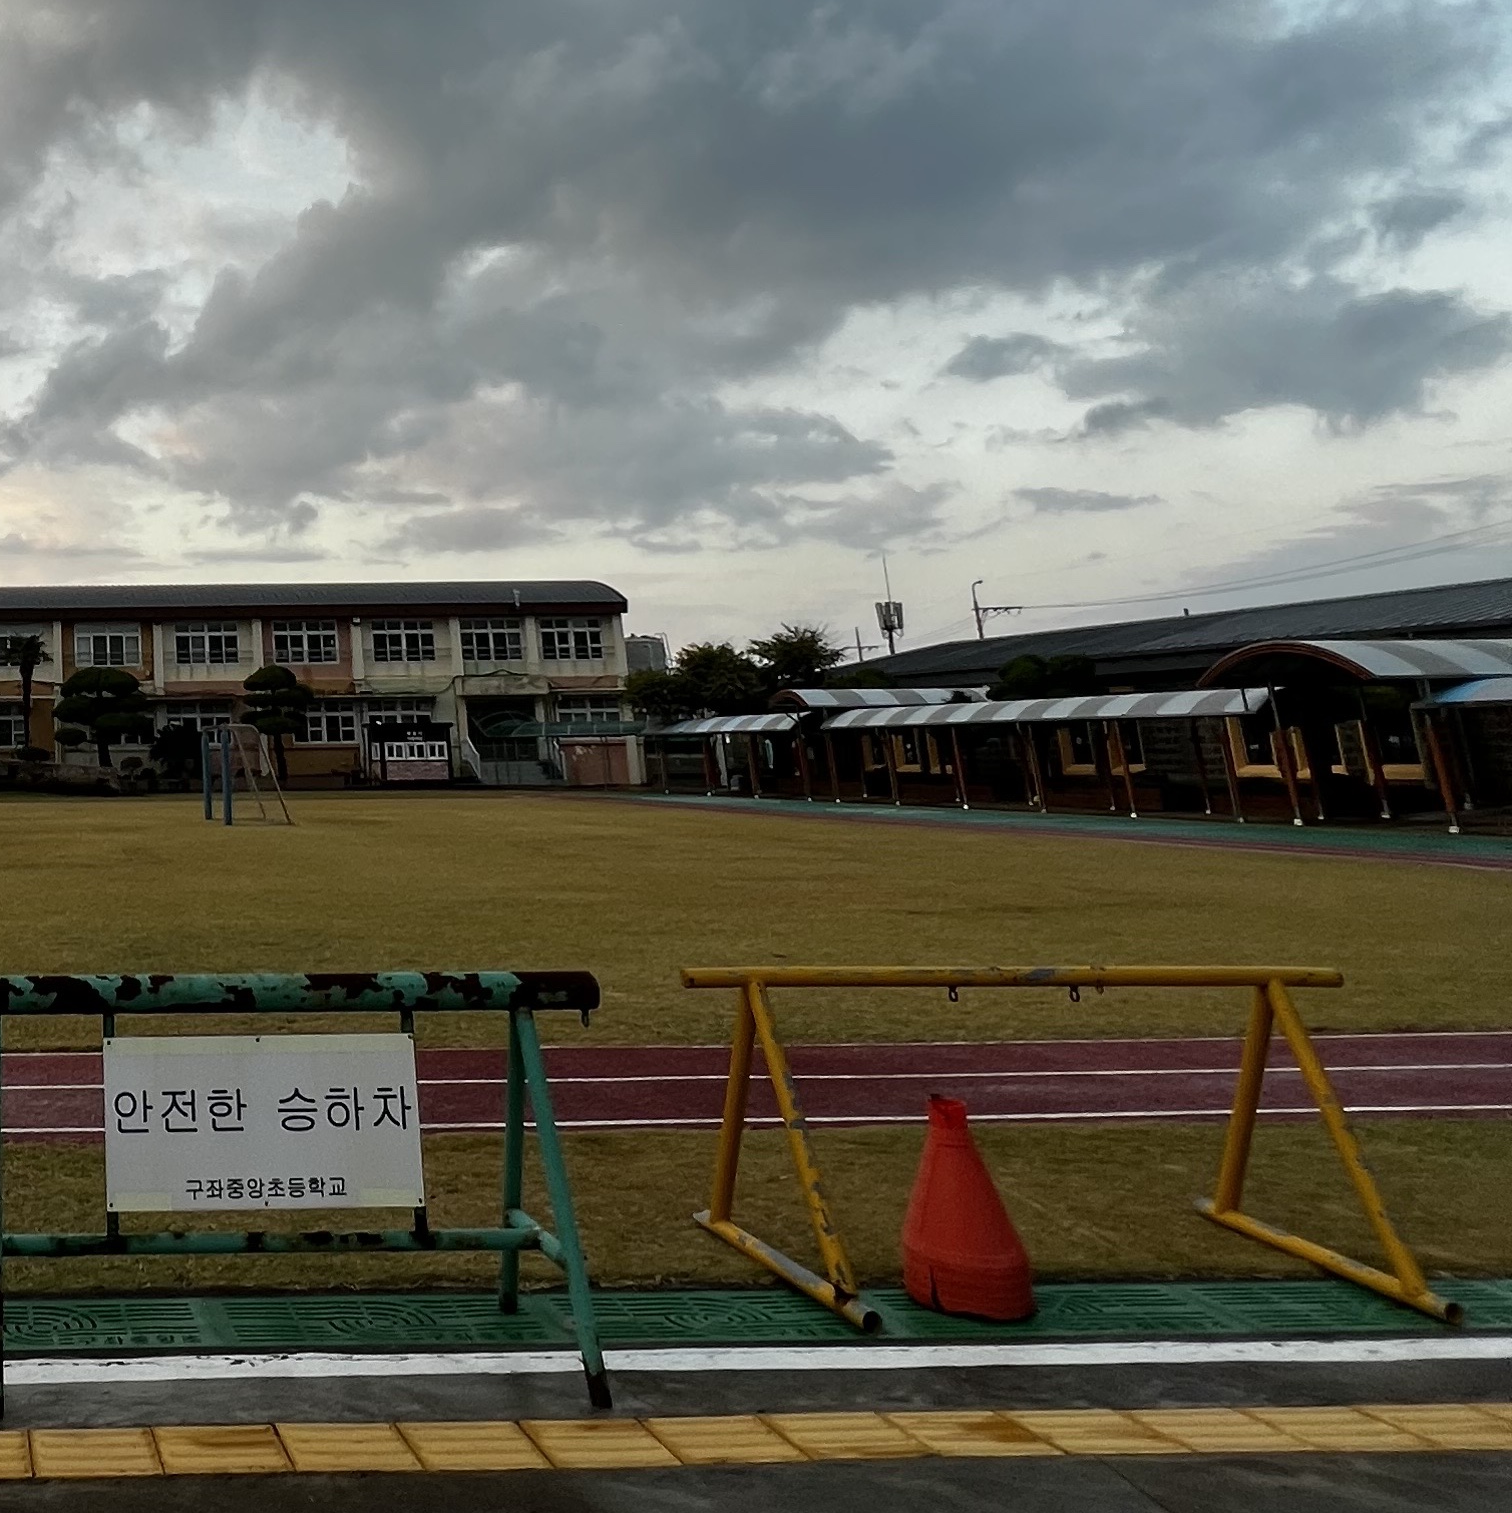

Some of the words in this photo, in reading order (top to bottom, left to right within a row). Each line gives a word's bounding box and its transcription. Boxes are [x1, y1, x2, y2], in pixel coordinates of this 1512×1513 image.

[113, 1088, 248, 1134] 안전한
[277, 1085, 412, 1132] 승하차
[185, 1176, 348, 1201] 구좌중앙초등학교
